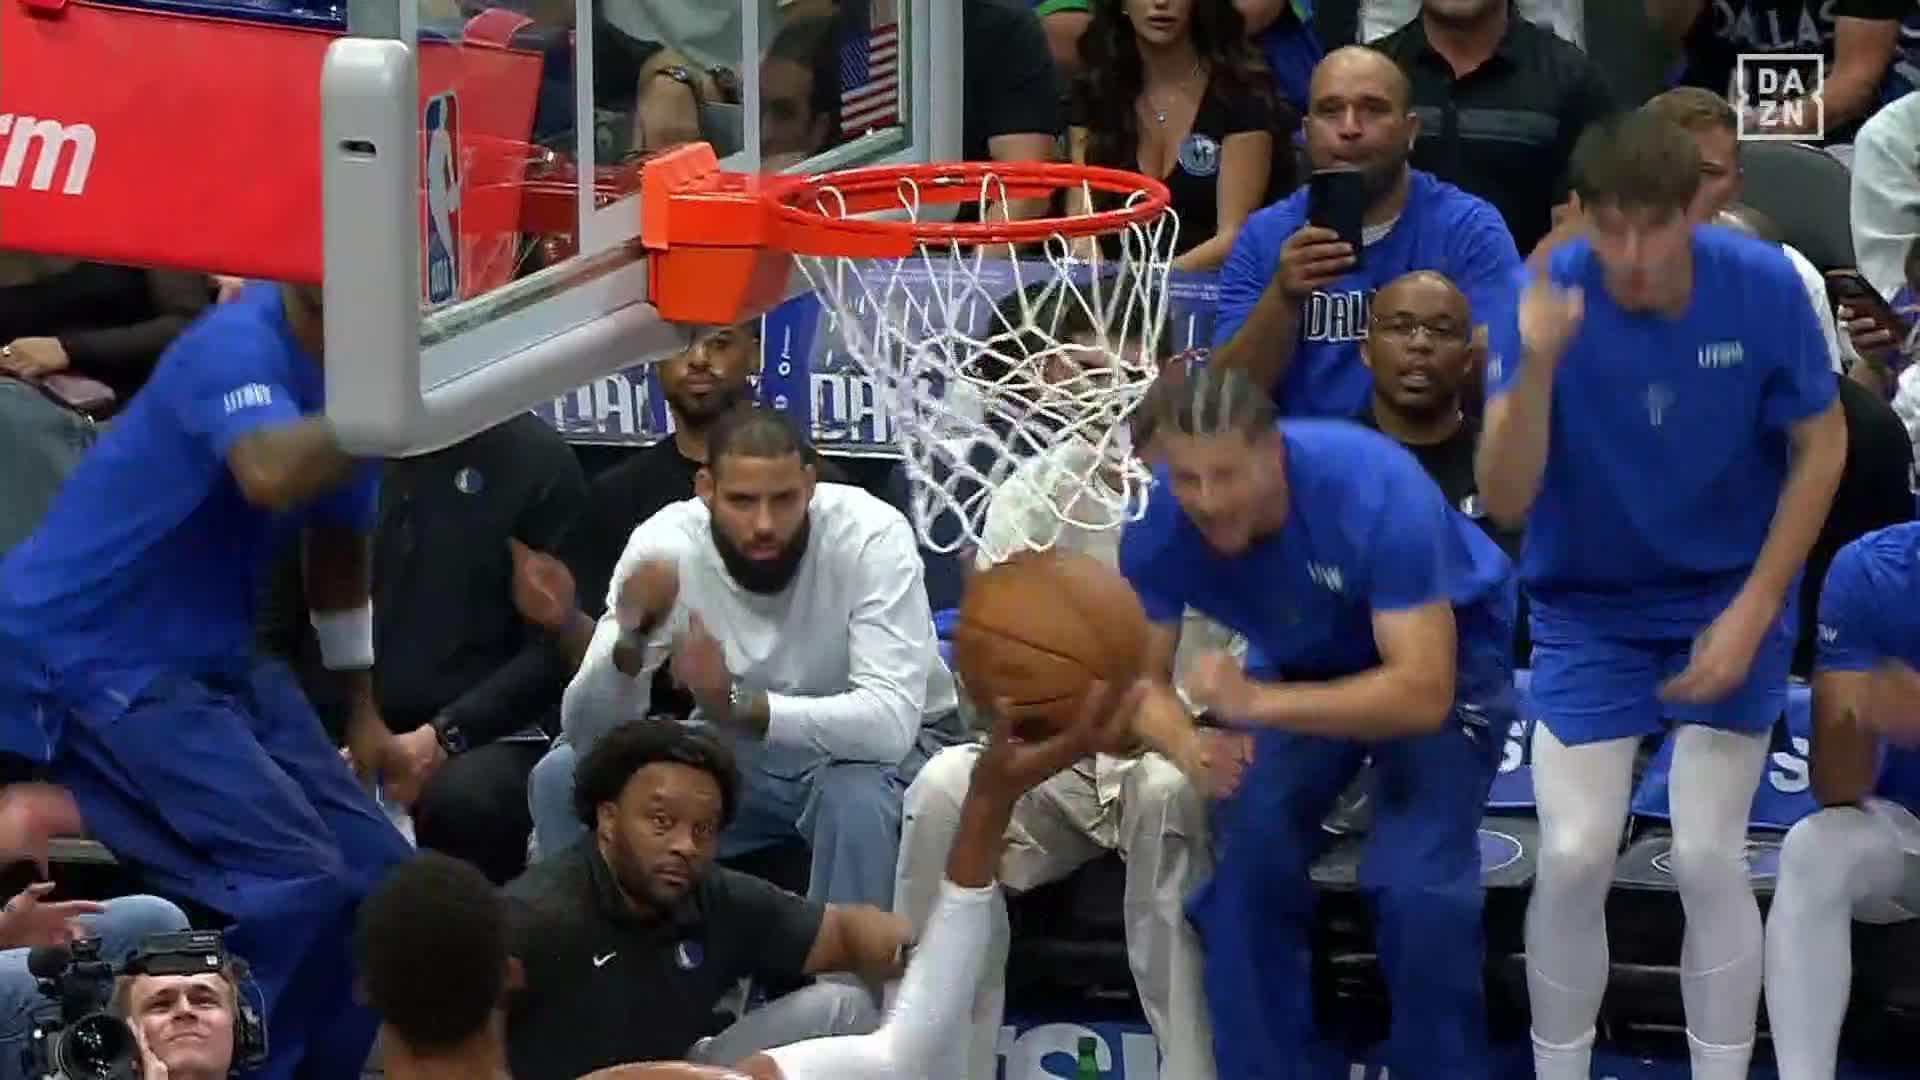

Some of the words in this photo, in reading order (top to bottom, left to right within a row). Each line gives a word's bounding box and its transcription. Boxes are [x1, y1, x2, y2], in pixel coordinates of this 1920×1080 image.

[0, 113, 96, 196] m
[1304, 290, 1371, 342] DAL
[811, 373, 897, 442] DA
